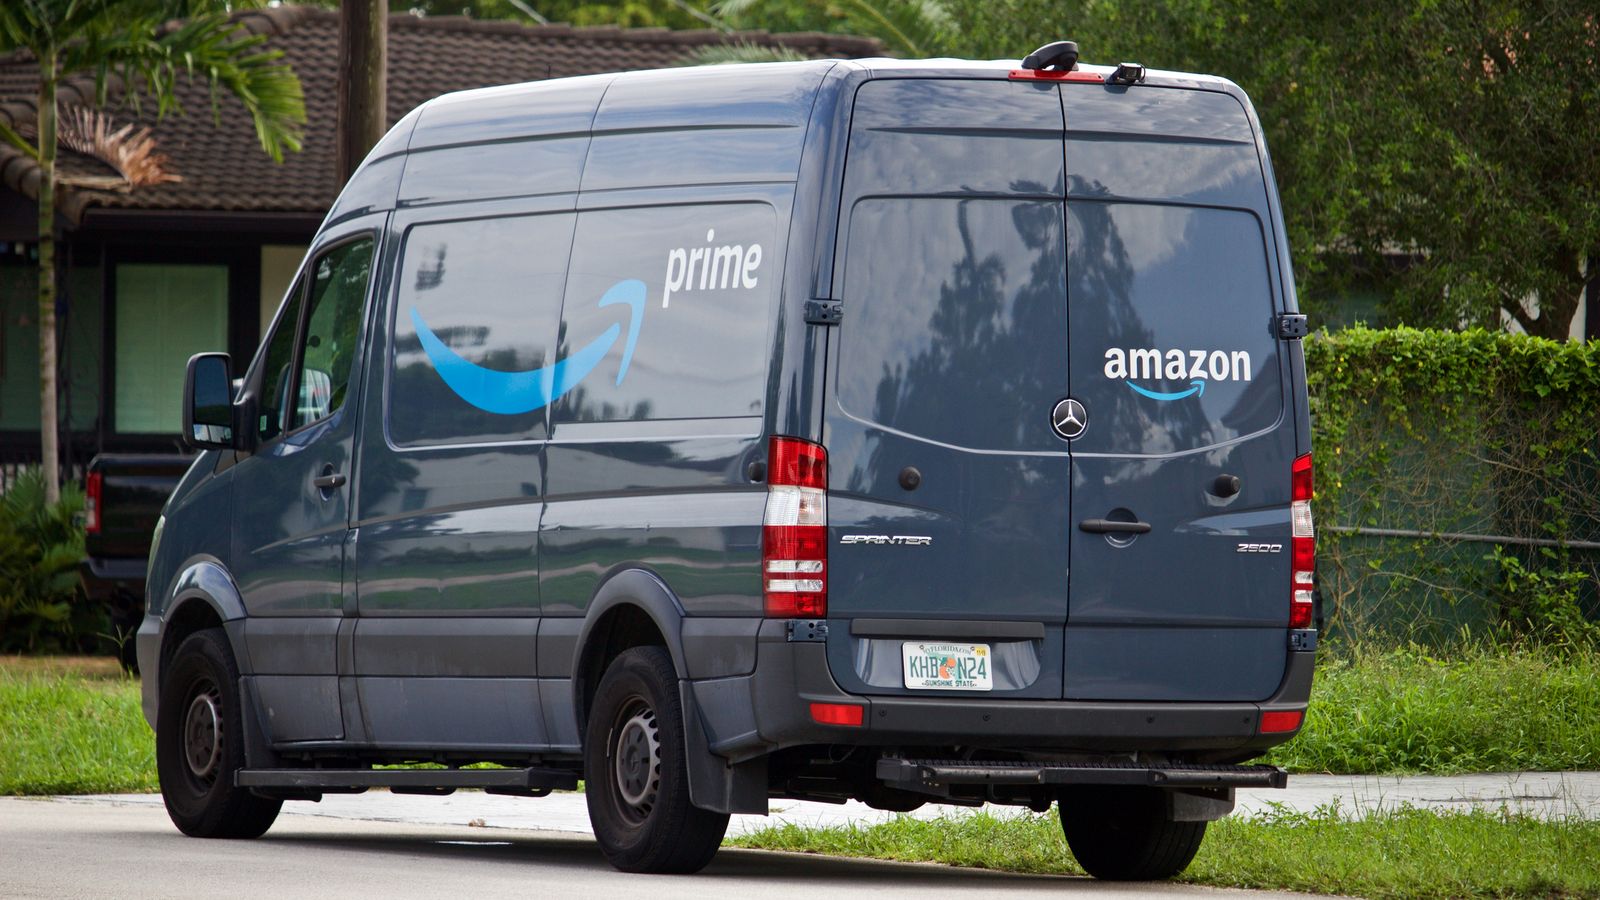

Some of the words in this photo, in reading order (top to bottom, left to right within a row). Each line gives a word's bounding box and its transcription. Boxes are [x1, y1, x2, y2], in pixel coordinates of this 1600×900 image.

[662, 228, 762, 308] prime
[1104, 347, 1252, 382] amazon
[840, 535, 932, 546] SPRINTER
[1236, 543, 1283, 553] 2500
[909, 655, 938, 679] KHB
[957, 657, 987, 680] N24
[925, 679, 953, 688] SUNSHINE
[955, 680, 974, 688] STATE
